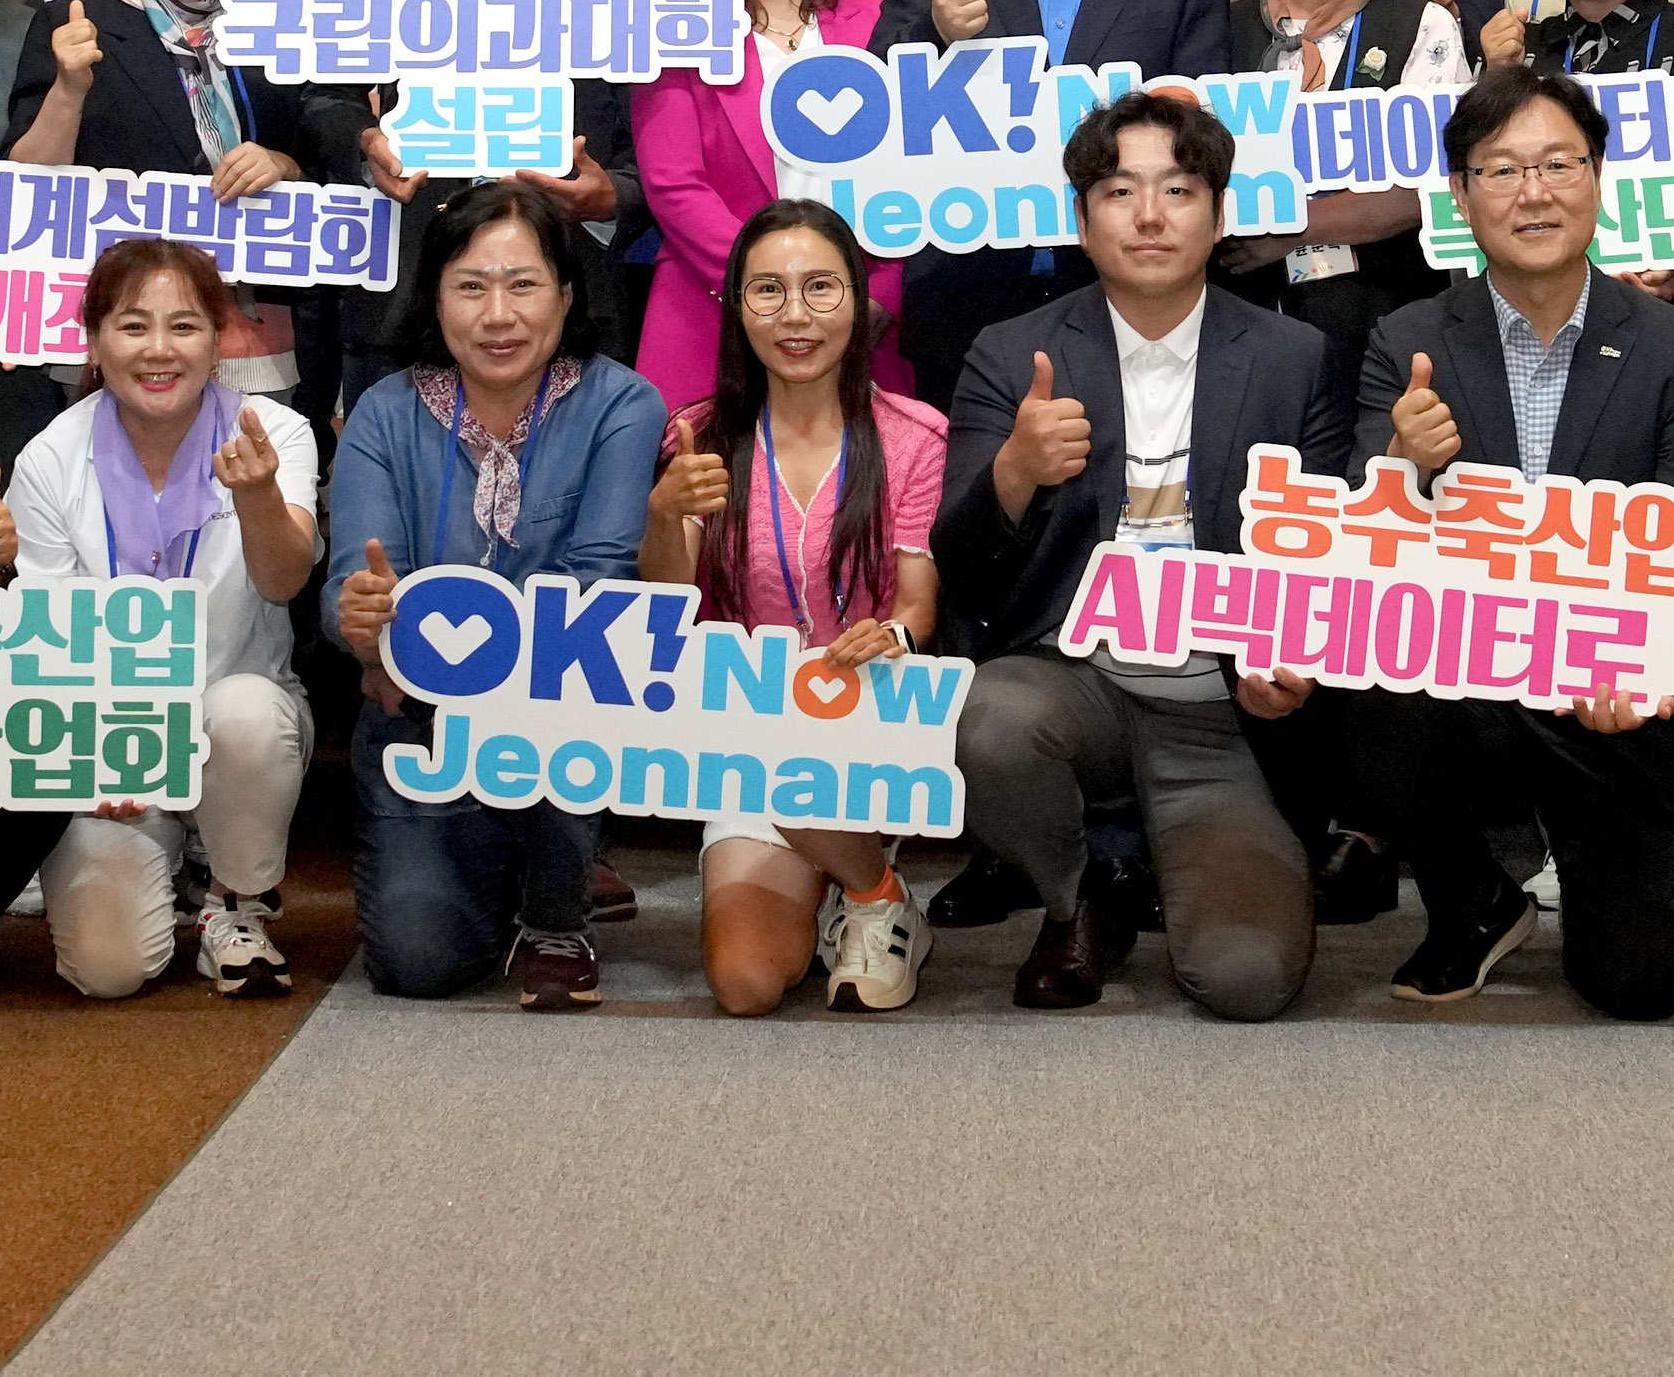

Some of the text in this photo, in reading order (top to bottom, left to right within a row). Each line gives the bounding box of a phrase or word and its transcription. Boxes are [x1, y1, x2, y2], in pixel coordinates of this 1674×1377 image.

[392, 87, 562, 167] 설립
[771, 47, 1290, 163] OK! Nw
[390, 575, 962, 726] OK! Now
[1070, 554, 1647, 699] AI빅데이터로
[394, 714, 953, 826] Jeonnam
